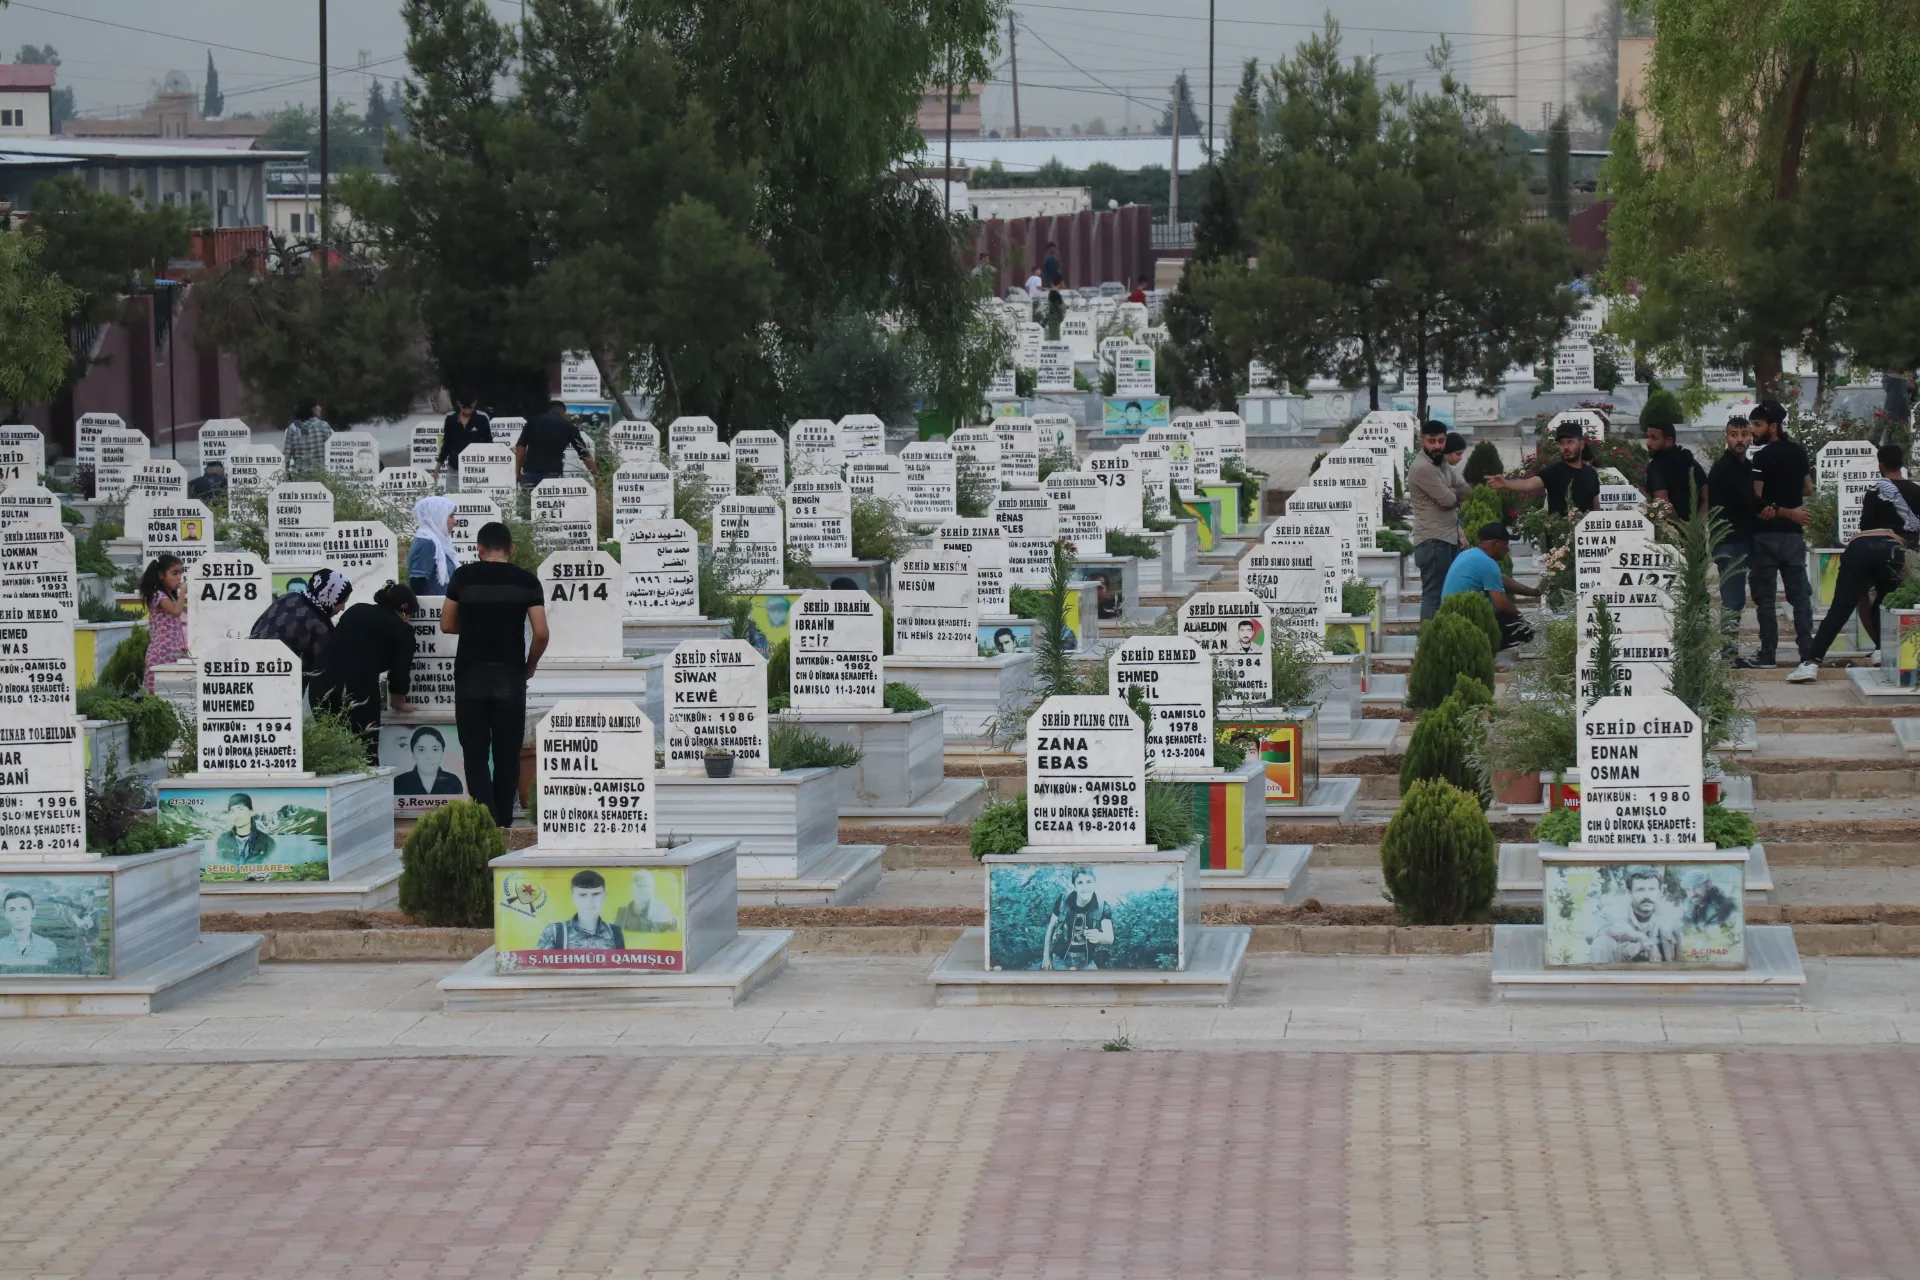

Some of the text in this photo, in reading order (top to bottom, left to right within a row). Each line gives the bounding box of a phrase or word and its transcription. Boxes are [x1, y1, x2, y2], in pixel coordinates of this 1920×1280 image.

[1615, 520, 1643, 529] GABAR
[1577, 536, 1616, 545] CIWAN
[1, 548, 37, 556] LOKMAN
[2, 561, 39, 570] YAKUT
[553, 560, 604, 579] ŞEHÎD
[42, 583, 67, 591] 1993
[201, 583, 257, 601] A/28
[551, 583, 608, 601] A/14
[27, 609, 58, 619] MEMO
[1158, 649, 1196, 662] EHMED
[204, 657, 293, 674] ŞEHÎD EGÎD
[28, 673, 63, 682] 1994
[1117, 671, 1158, 683] EHMED
[203, 682, 254, 695] MUBAREK
[835, 685, 875, 694] 11-3-2014
[29, 694, 70, 702] 12-3-2014
[203, 700, 254, 713] MUHEMED
[720, 713, 754, 722] 1986
[1109, 714, 1129, 727] CIYA
[256, 722, 292, 732] 1994
[1169, 722, 1198, 732] 1978
[1643, 717, 1693, 735] CÎHAD
[223, 733, 276, 745] QAMIŞLO
[543, 736, 598, 752] MEHMÛD
[1038, 737, 1088, 751] ZANA
[203, 747, 215, 757] CIH
[1161, 748, 1205, 758] 12-3-2004
[1591, 745, 1638, 760] EDNAN
[203, 758, 297, 771] QAMIŞLO 21-3-2012
[1038, 756, 1088, 769] EBAS
[1590, 766, 1640, 779] OSMAN
[593, 782, 645, 795] QAMIŞLO
[37, 797, 77, 807] 1996
[597, 796, 640, 807] 1997
[1093, 795, 1128, 806] 1998
[1649, 791, 1690, 802] 1980
[543, 810, 558, 821] CIH
[1034, 807, 1048, 818] CIH
[1616, 806, 1666, 818] QAMIŞLO
[543, 823, 586, 833] MUNBIC
[1078, 821, 1136, 831] 19-8-2014
[1587, 820, 1601, 831] CIH
[239, 863, 292, 873] MUBAREK
[611, 954, 676, 966] QAMIŞLO
